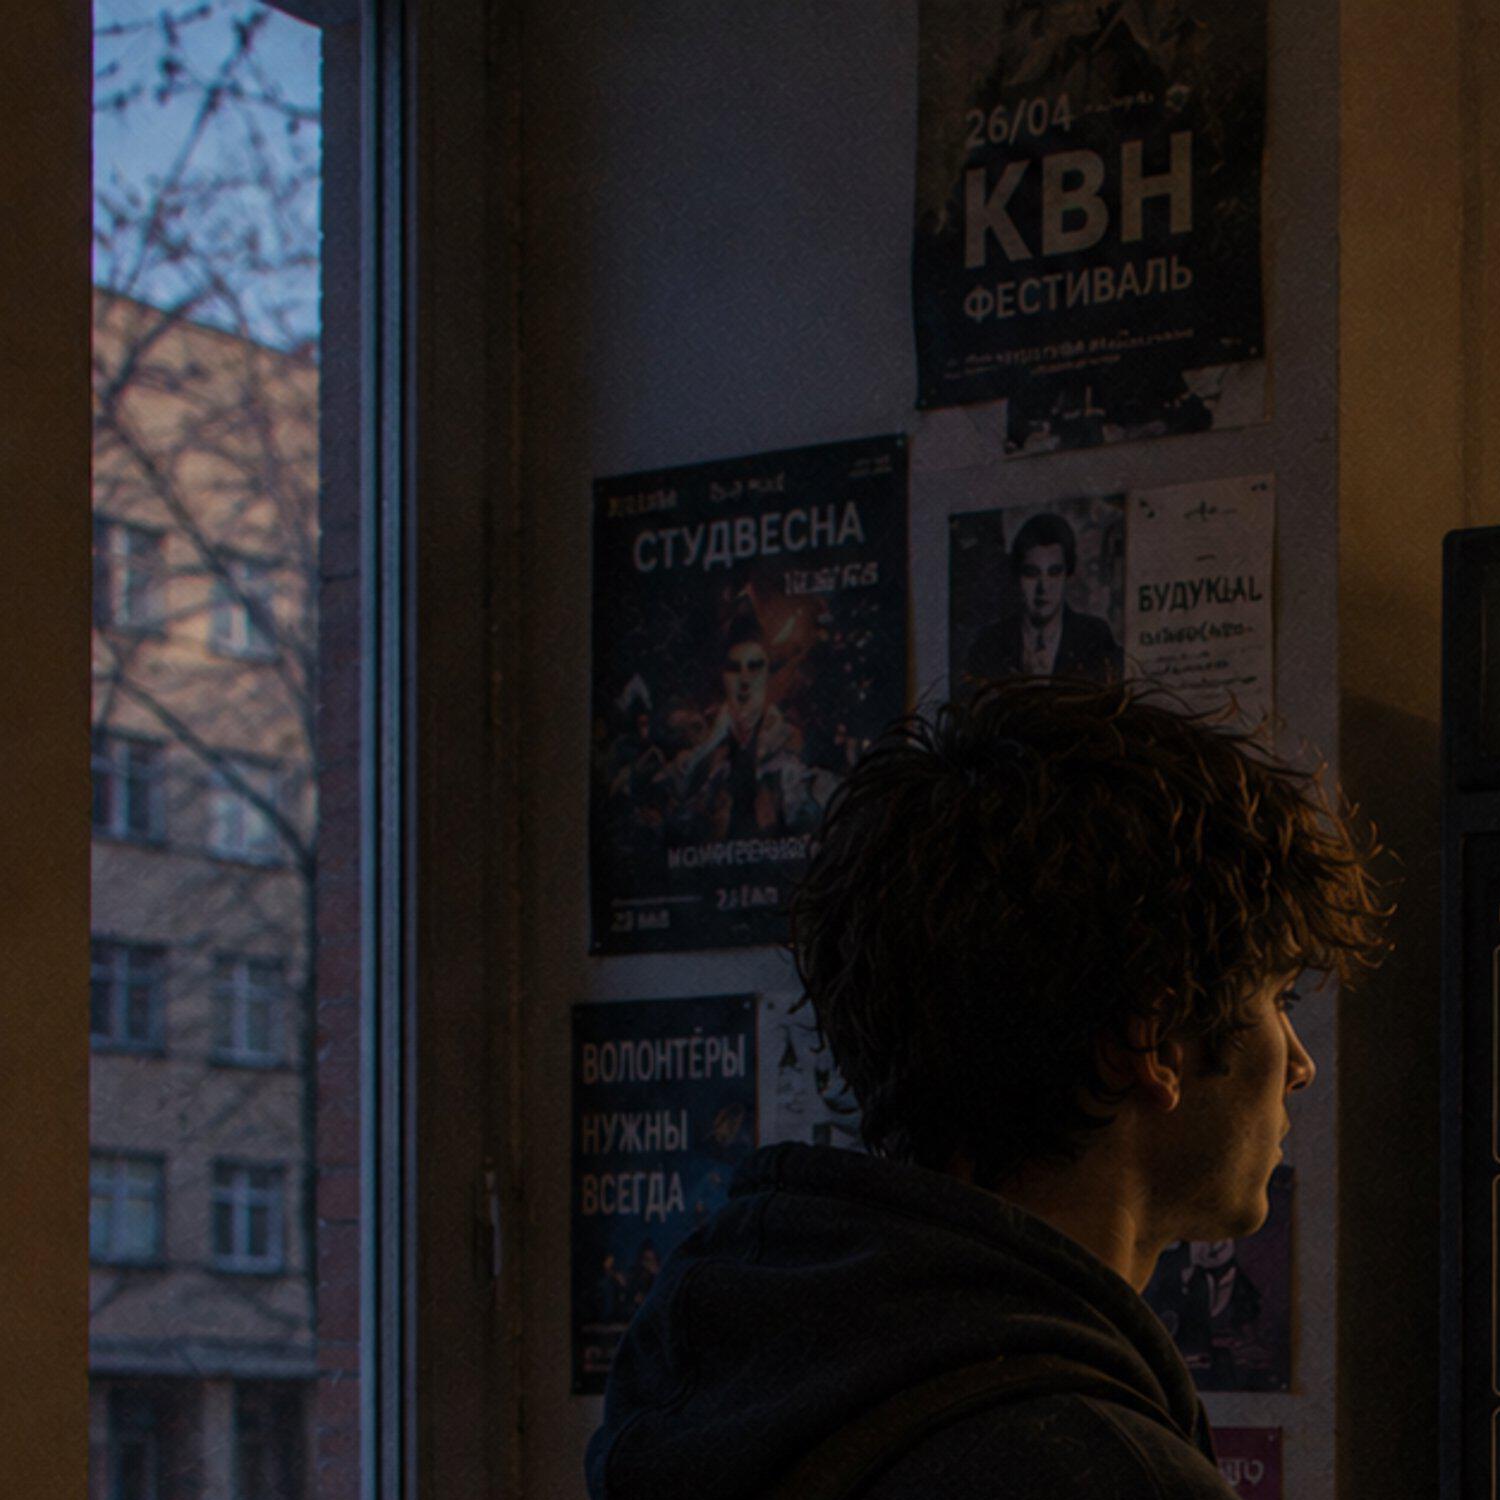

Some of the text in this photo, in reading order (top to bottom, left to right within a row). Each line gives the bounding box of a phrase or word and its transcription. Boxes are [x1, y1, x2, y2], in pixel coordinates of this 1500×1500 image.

[965, 93, 1076, 148] 26/04
[963, 130, 1196, 270] КВН
[963, 254, 1195, 323] ФЕСТИВАЛЬ
[632, 500, 866, 572] СТУДВЕСНА
[580, 1109, 688, 1155] НУЖНЫ
[580, 1171, 685, 1224] ВСЕГДА
